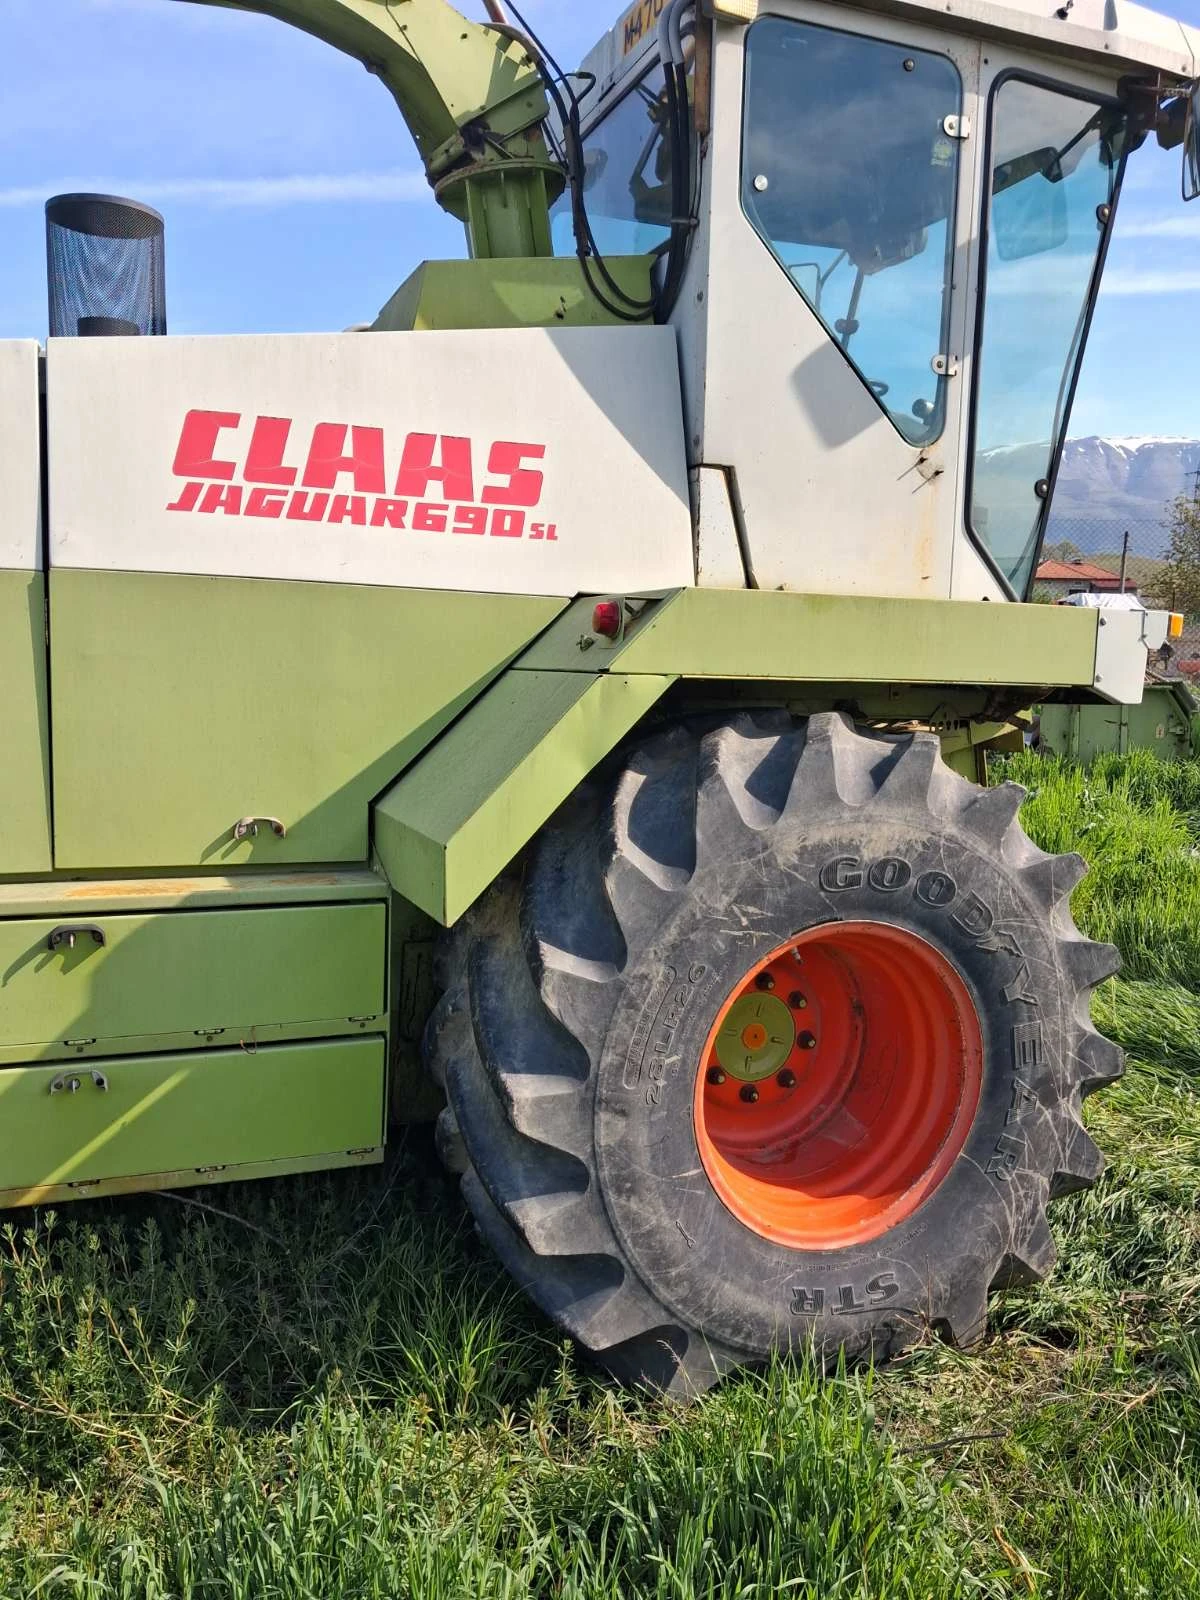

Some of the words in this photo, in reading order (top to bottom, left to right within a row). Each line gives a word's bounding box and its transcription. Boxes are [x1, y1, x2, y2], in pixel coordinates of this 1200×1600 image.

[172, 409, 546, 507] CLAAS
[528, 523, 558, 541] SL
[819, 855, 1044, 1182] GOODYEAR
[789, 1271, 899, 1316] STR
